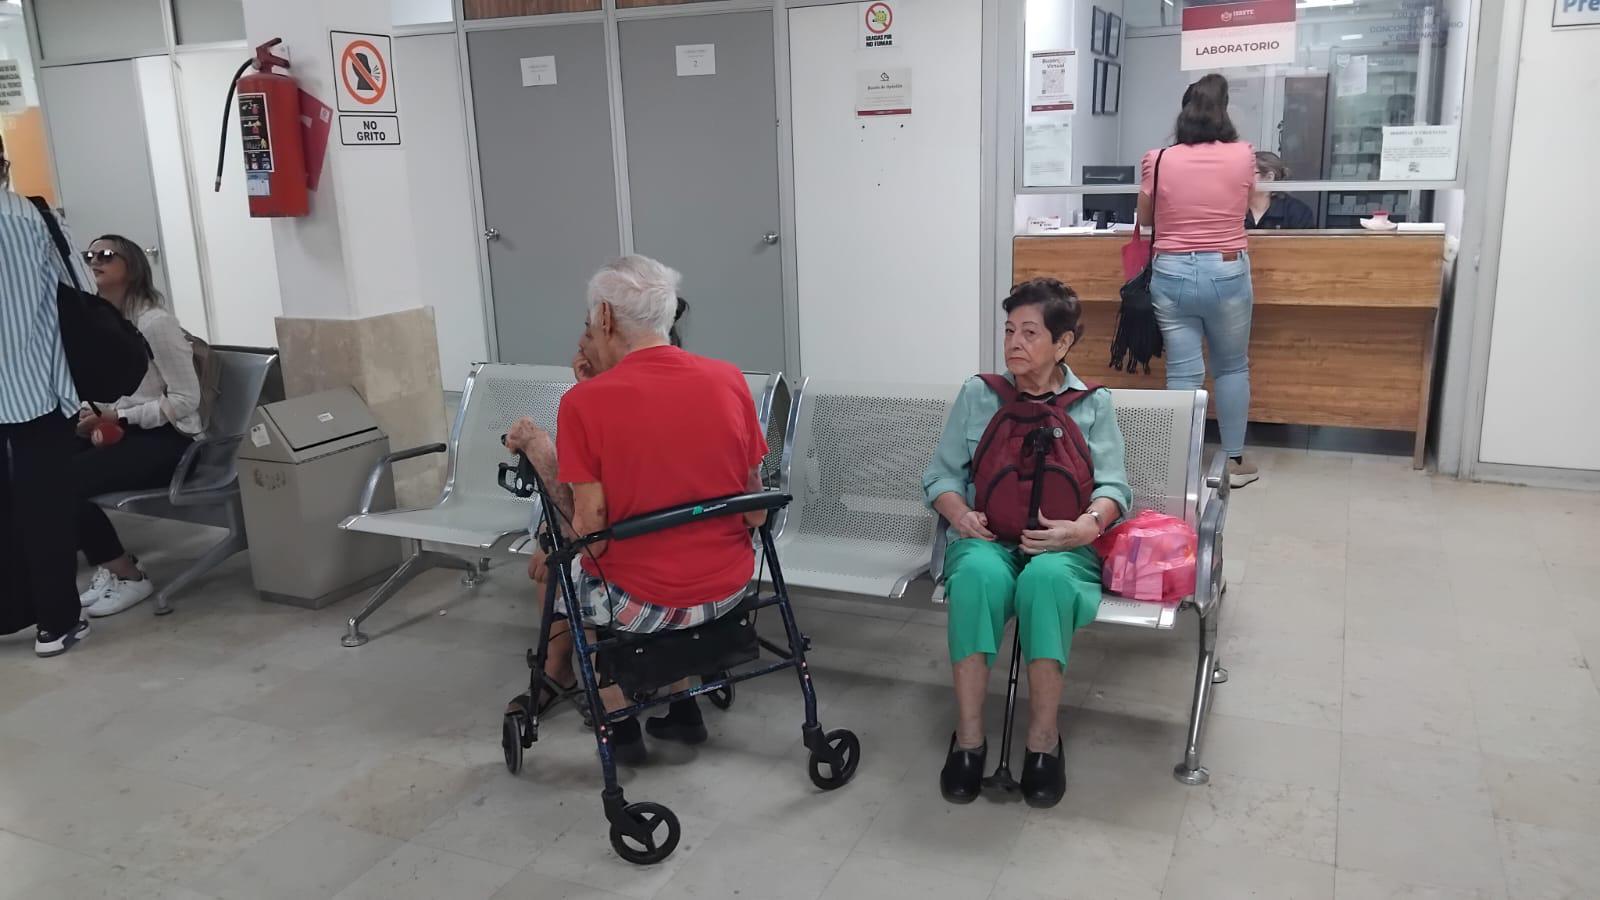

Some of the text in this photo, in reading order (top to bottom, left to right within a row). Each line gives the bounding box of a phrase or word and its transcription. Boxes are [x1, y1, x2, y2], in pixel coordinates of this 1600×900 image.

[1195, 41, 1280, 56] LABORATORIO
[363, 121, 377, 130] NO
[356, 131, 386, 142] GRITO
